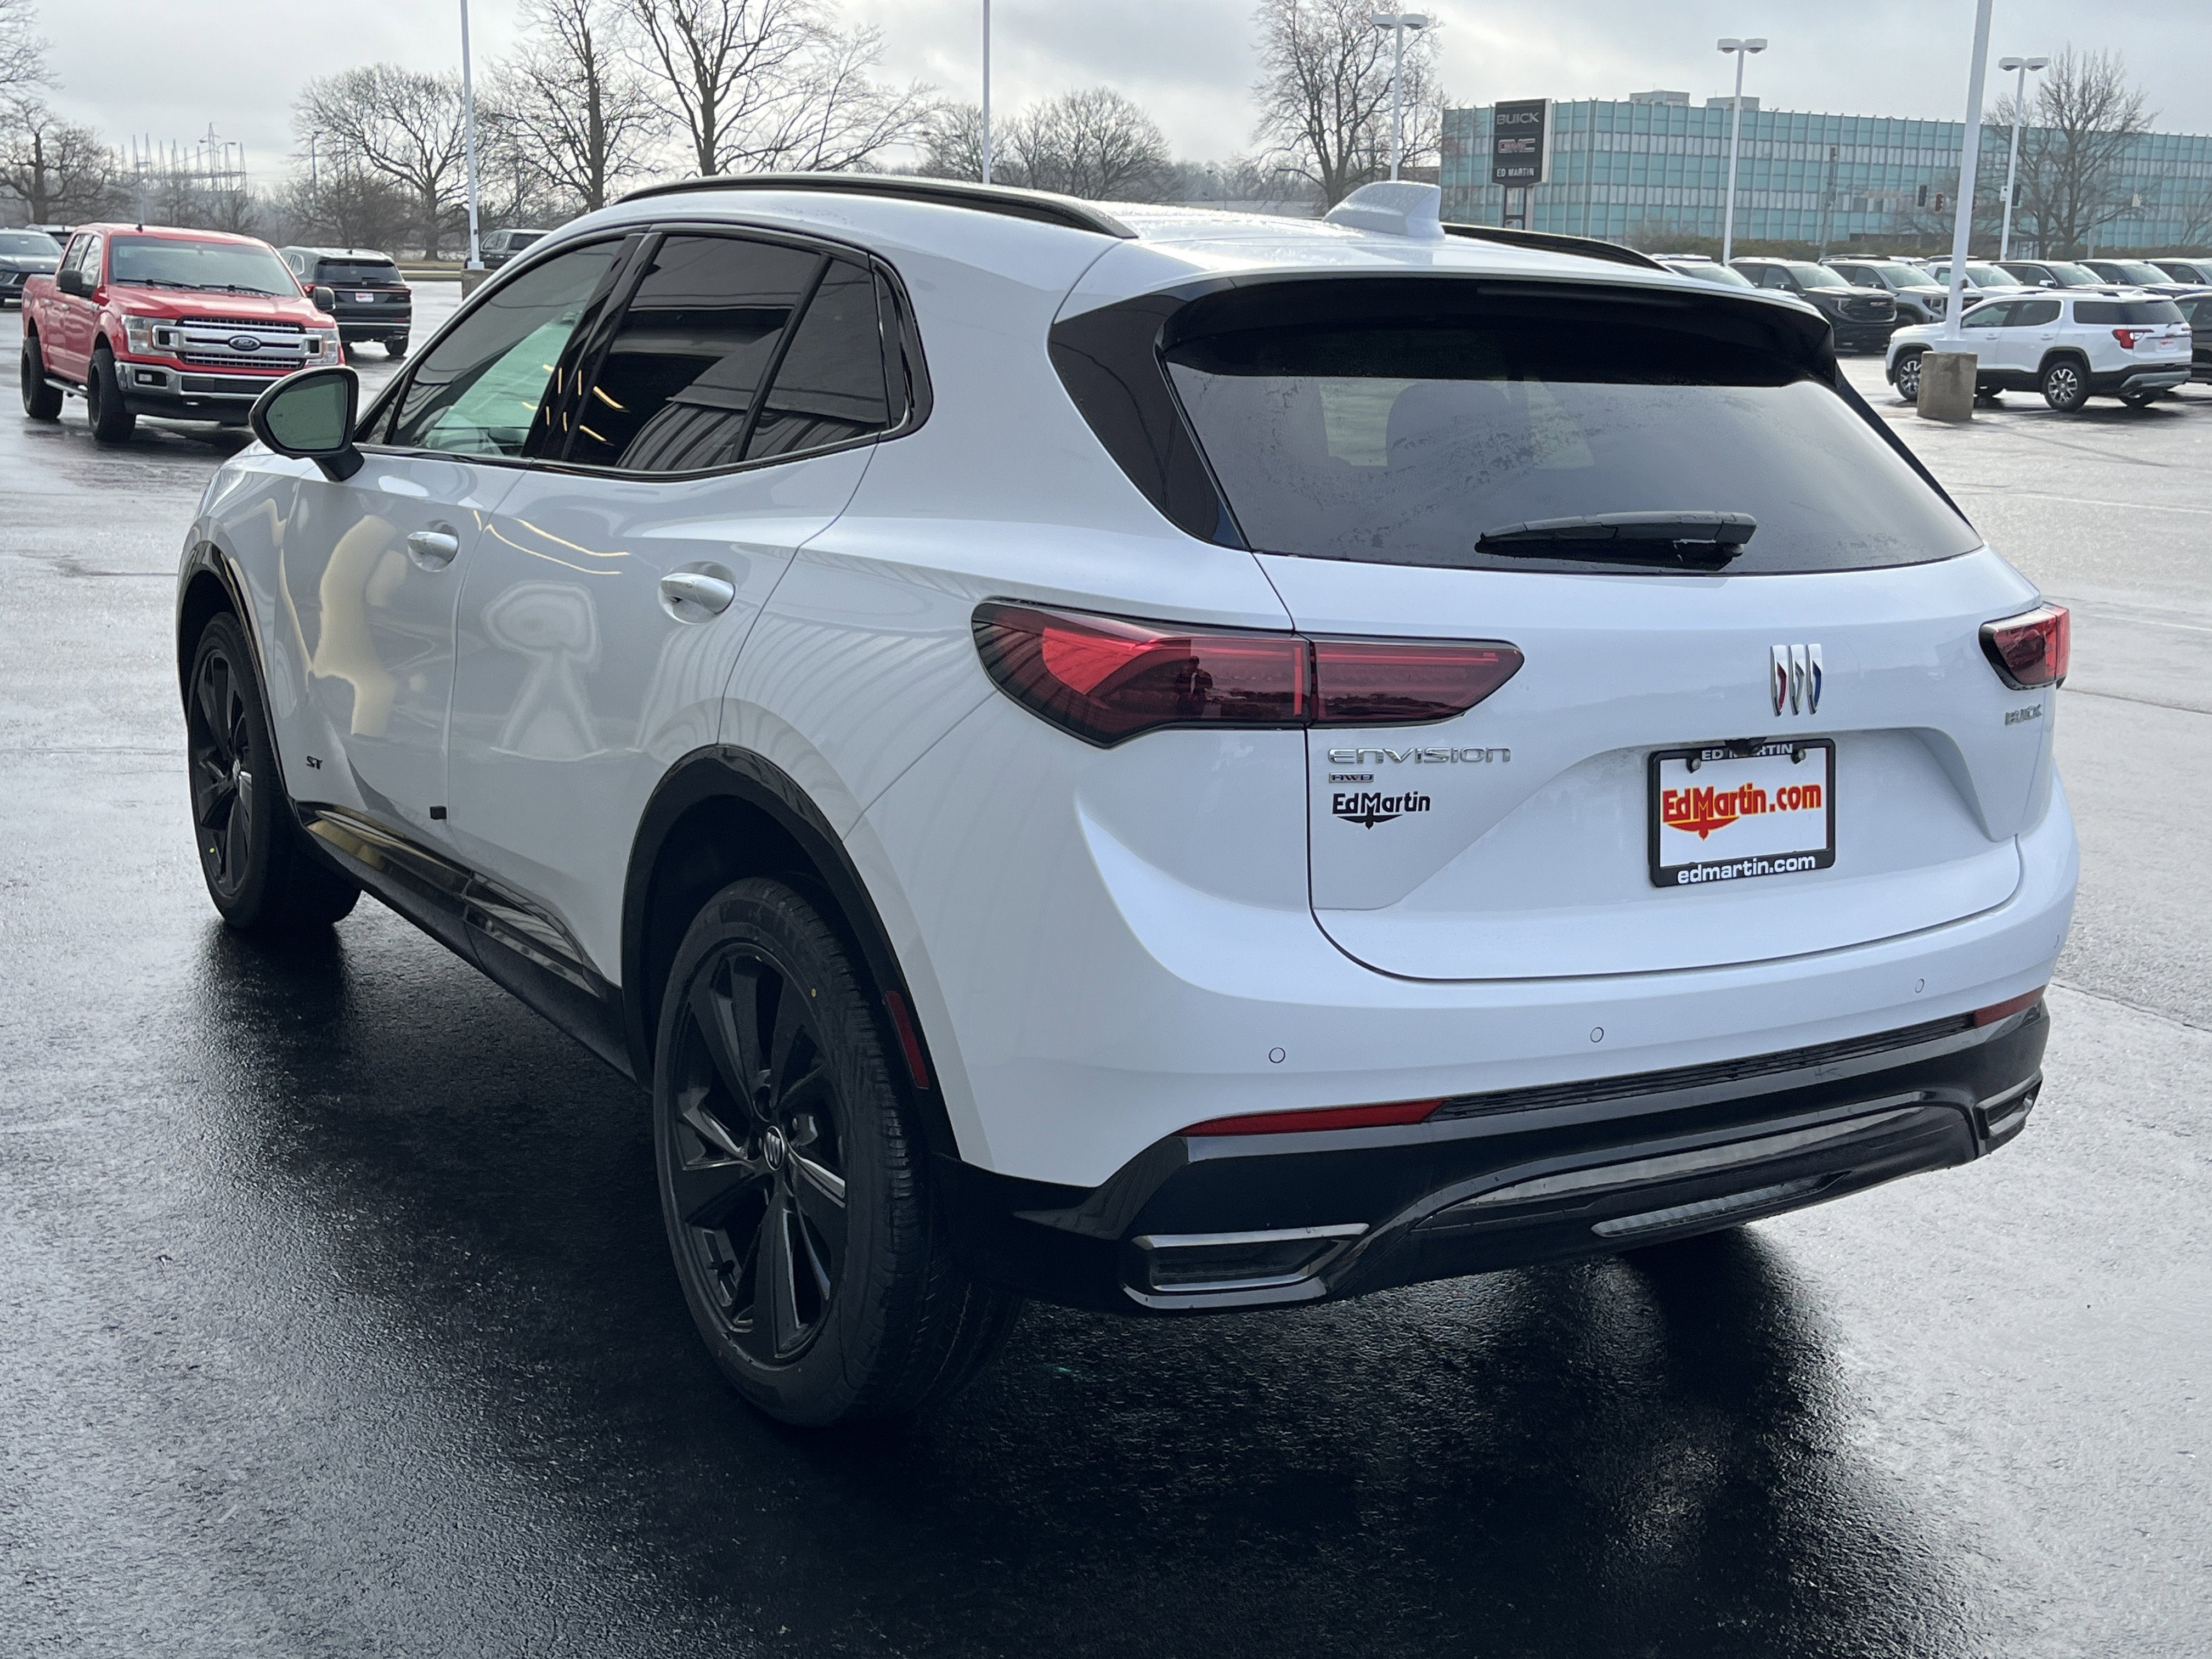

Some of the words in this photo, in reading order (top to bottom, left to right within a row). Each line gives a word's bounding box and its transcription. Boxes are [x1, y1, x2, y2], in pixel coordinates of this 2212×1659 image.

[1496, 112, 1539, 125] BUICK
[1498, 138, 1536, 154] GMC
[1496, 168, 1506, 177] ED
[1508, 167, 1535, 177] MARTIN
[2005, 704, 2042, 725] BUICK
[306, 755, 323, 770] ST
[1701, 749, 1724, 761] ED
[1677, 855, 1816, 884] edmartin.com
